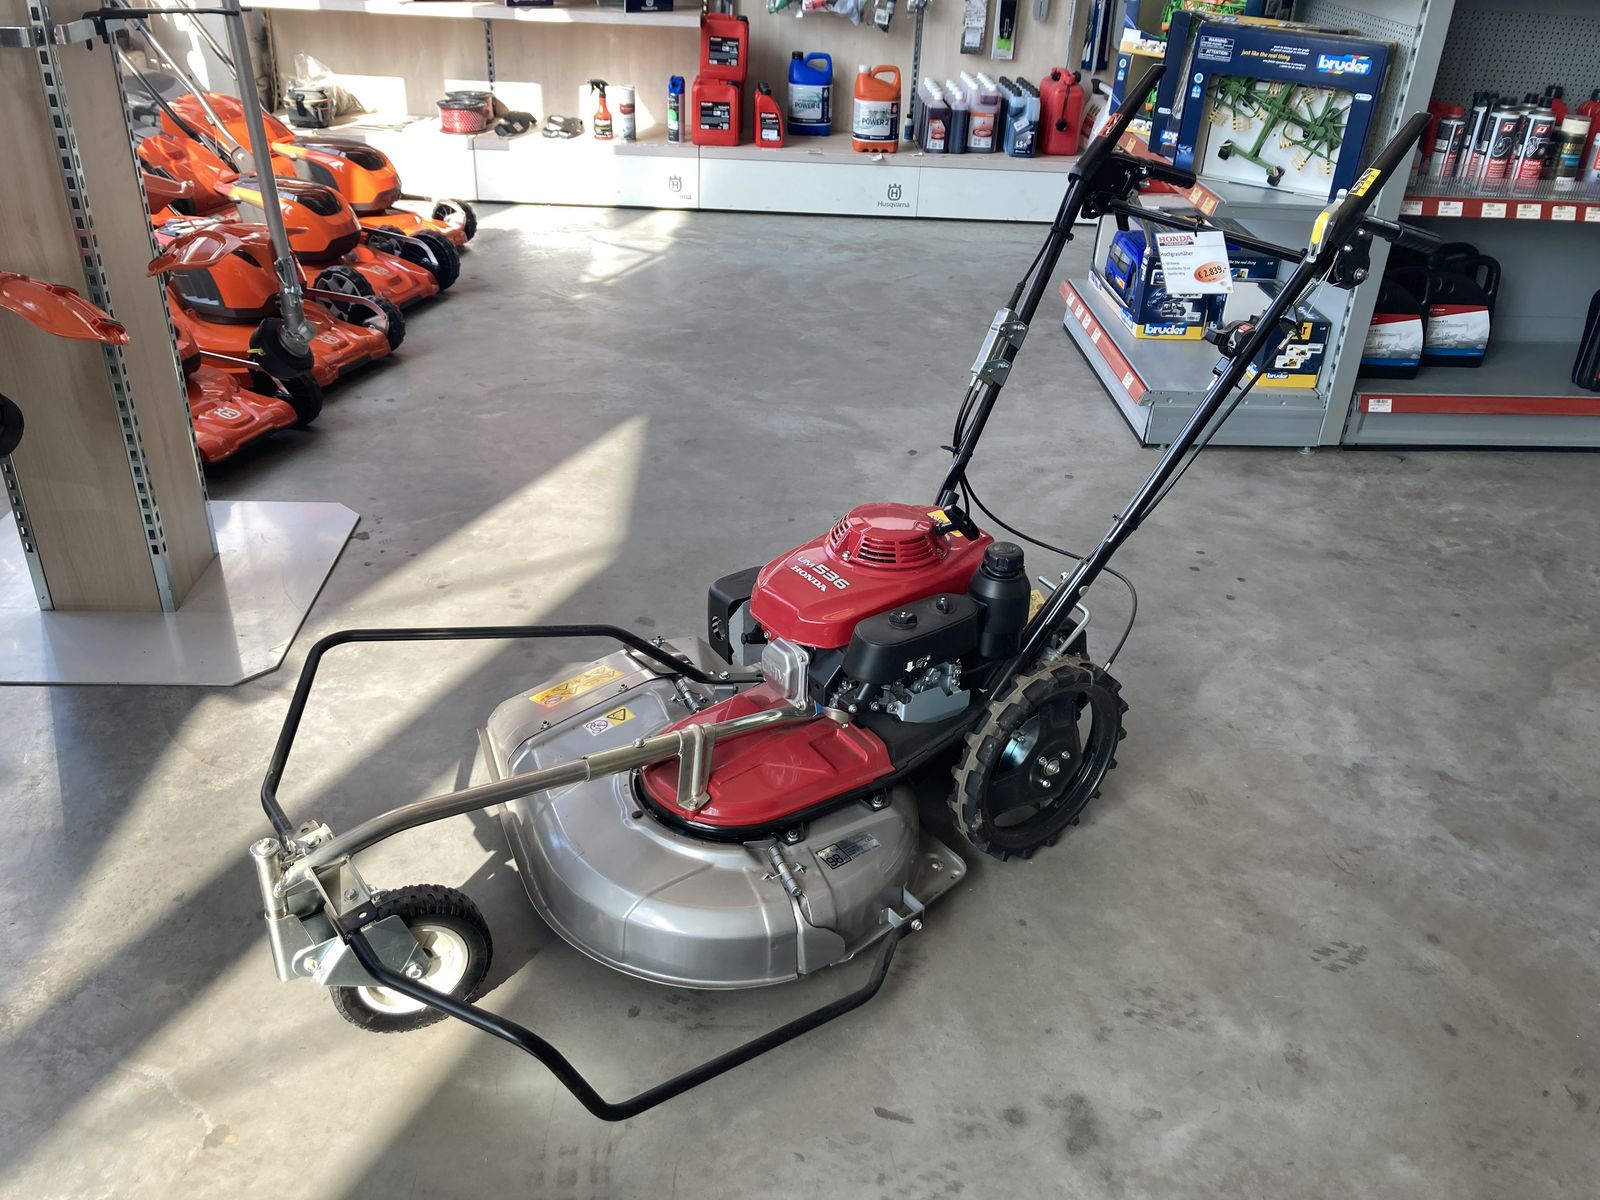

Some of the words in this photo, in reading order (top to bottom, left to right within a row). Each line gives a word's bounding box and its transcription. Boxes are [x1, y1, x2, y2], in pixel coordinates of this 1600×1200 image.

[1278, 53, 1291, 61] thing
[1318, 54, 1369, 73] bruder
[862, 117, 884, 126] POWER
[1203, 265, 1227, 278] 2.839,-
[1144, 324, 1186, 335] bruder
[791, 565, 827, 592] HONDA
